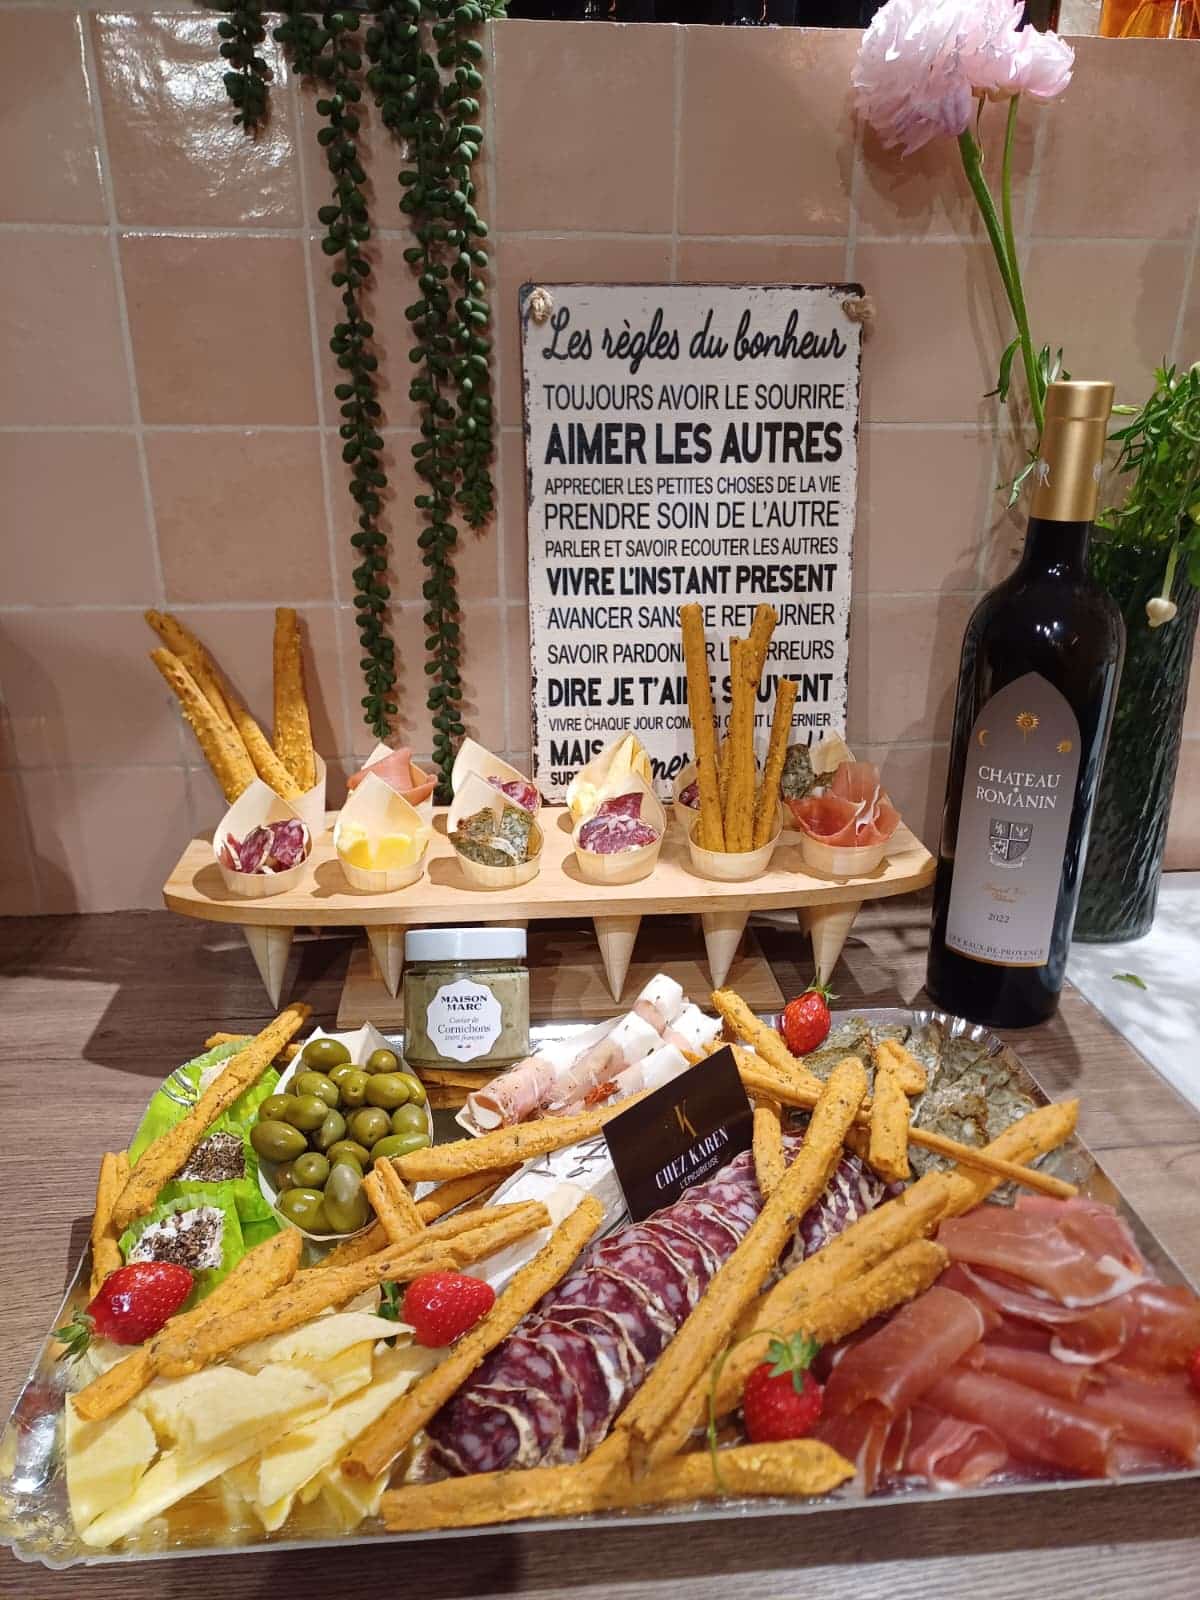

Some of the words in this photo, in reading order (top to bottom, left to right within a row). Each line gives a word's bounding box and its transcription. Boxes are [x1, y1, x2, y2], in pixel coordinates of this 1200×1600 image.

[543, 307, 593, 360] Les
[602, 307, 680, 375] règles
[689, 309, 728, 360] du
[734, 308, 847, 361] bonheur
[543, 384, 653, 411] TOUJOURS
[658, 384, 719, 410] AVOIR
[725, 384, 749, 410] LE
[755, 383, 845, 410] SOURIRE
[544, 422, 647, 465] AIMER
[655, 422, 712, 464] LES
[719, 421, 843, 464] AUTRES
[544, 477, 624, 496] APPRECIER
[627, 477, 653, 495] LES
[657, 476, 713, 495] PETITES
[717, 476, 774, 494] CHOSES
[777, 475, 796, 494] DE
[799, 475, 816, 493] LA
[819, 475, 841, 493] VIE
[544, 502, 650, 530] PRENDRE
[657, 502, 709, 529] SOIN
[716, 502, 745, 529] DE
[751, 500, 840, 528] L'AUTRE
[545, 540, 600, 558] PARLER
[604, 540, 622, 557] ET
[625, 539, 678, 558] SAVOIR
[681, 538, 749, 557] ECOUTER
[752, 538, 779, 556] LES
[782, 537, 839, 555] AUTRES
[546, 567, 615, 596] VIVRE
[620, 565, 731, 595] L'INSTANT
[735, 563, 838, 594] PRESENT
[547, 606, 632, 629] AVANCER
[721, 603, 835, 628] RETURNER
[547, 644, 608, 664] SAVOIR
[613, 642, 717, 664] PARDONR
[765, 640, 834, 661] RREURS
[548, 678, 602, 707] DIRE
[607, 677, 635, 706] JE
[721, 673, 834, 704] SUVNT
[549, 718, 582, 732] VIVRE
[585, 717, 631, 731] CHAQUE
[633, 716, 664, 730] JOUR
[666, 715, 693, 730] COM
[790, 713, 832, 728] ERNIER
[550, 739, 605, 767] MAIS
[978, 765, 1063, 790] CHATEAU
[975, 785, 1058, 810] ROMANIN
[988, 912, 1010, 924] 2022
[441, 995, 487, 1003] MAISON
[447, 1003, 482, 1011] MARC
[437, 1023, 491, 1034] Cornichons
[655, 1153, 689, 1190] CHEZ
[688, 1125, 729, 1166] KAREN
